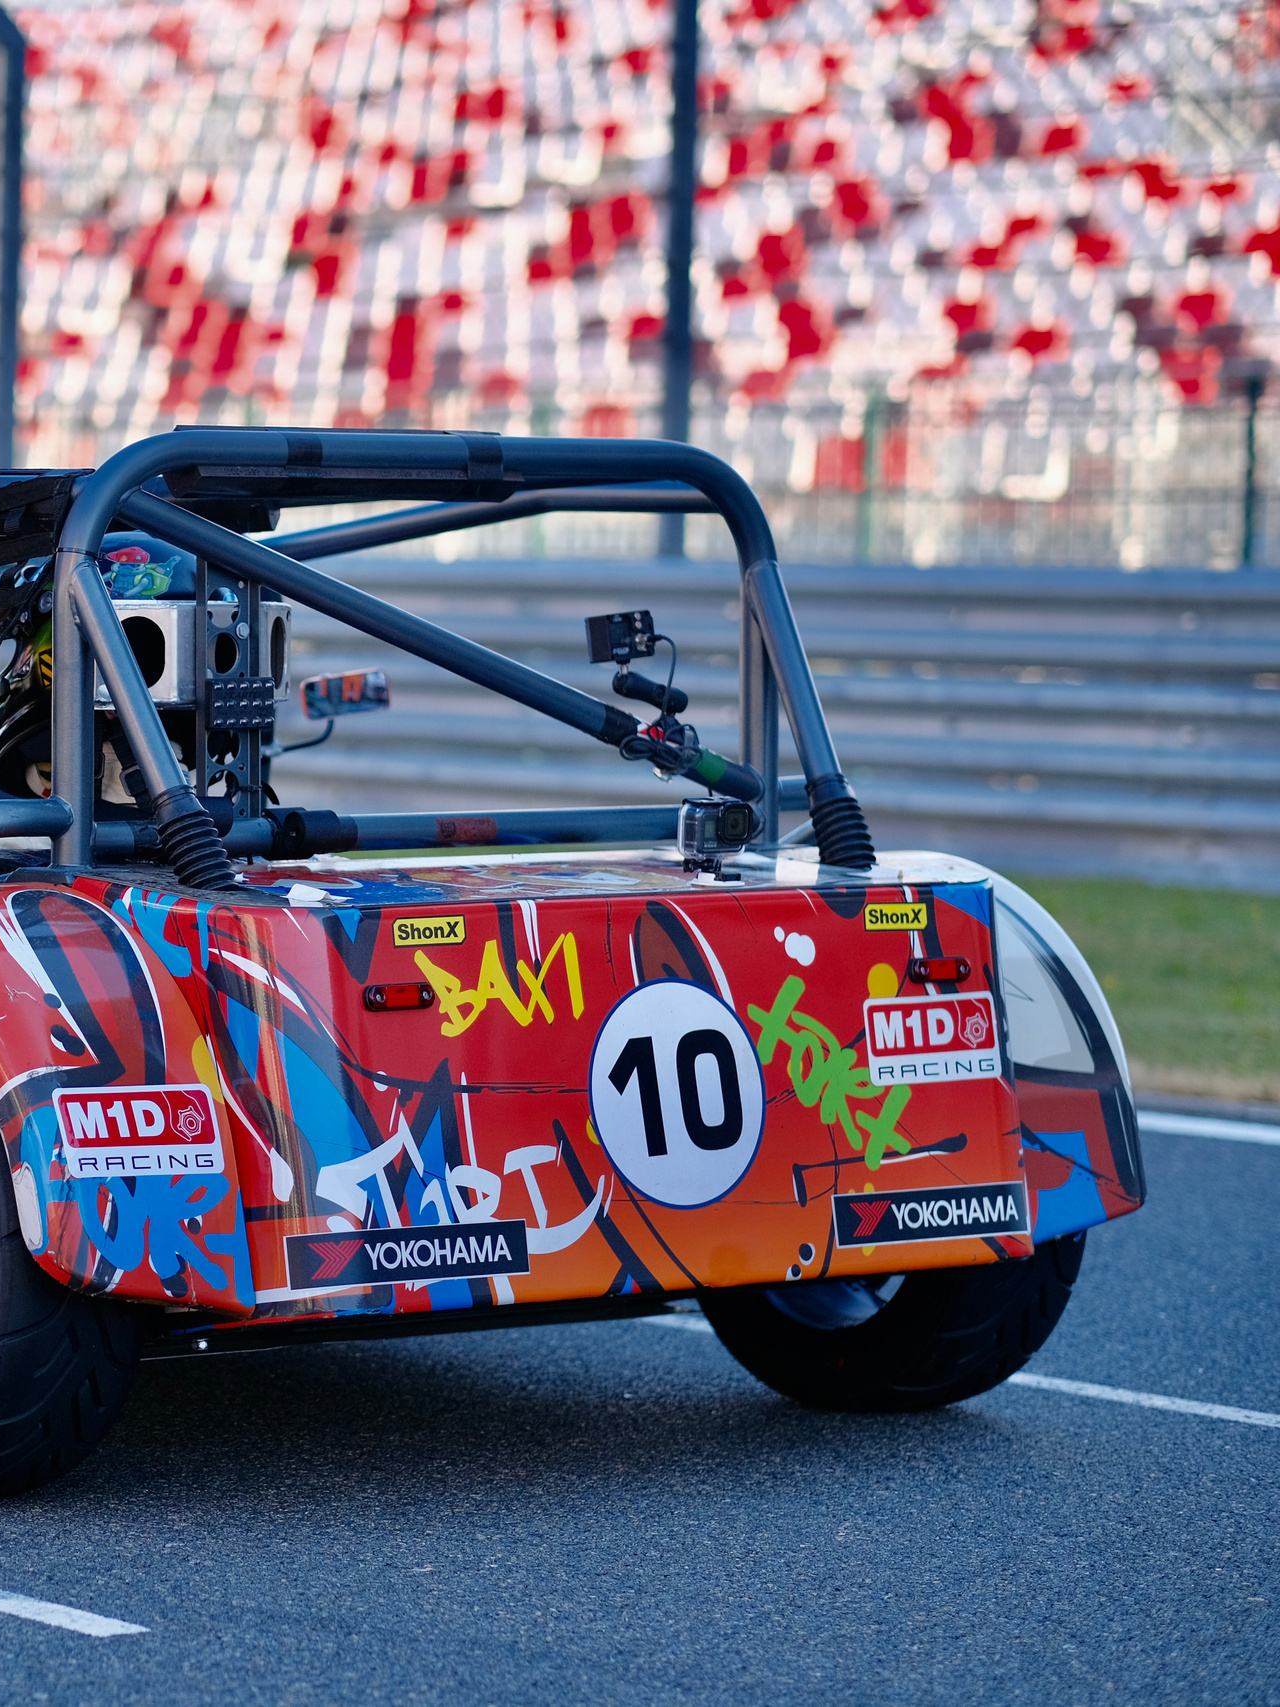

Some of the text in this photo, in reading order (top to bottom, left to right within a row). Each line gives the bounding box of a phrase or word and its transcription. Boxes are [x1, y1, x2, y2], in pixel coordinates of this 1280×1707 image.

[397, 920, 460, 941] ShonX
[868, 908, 922, 925] ShonX
[872, 1007, 955, 1050] M1D
[878, 1058, 995, 1080] RACING
[607, 1028, 744, 1158] 10
[66, 1099, 165, 1140] M1D
[78, 1153, 214, 1172] RACING
[891, 1194, 1019, 1230] YOKOHAMA
[364, 1234, 512, 1271] YOKOHAMA
